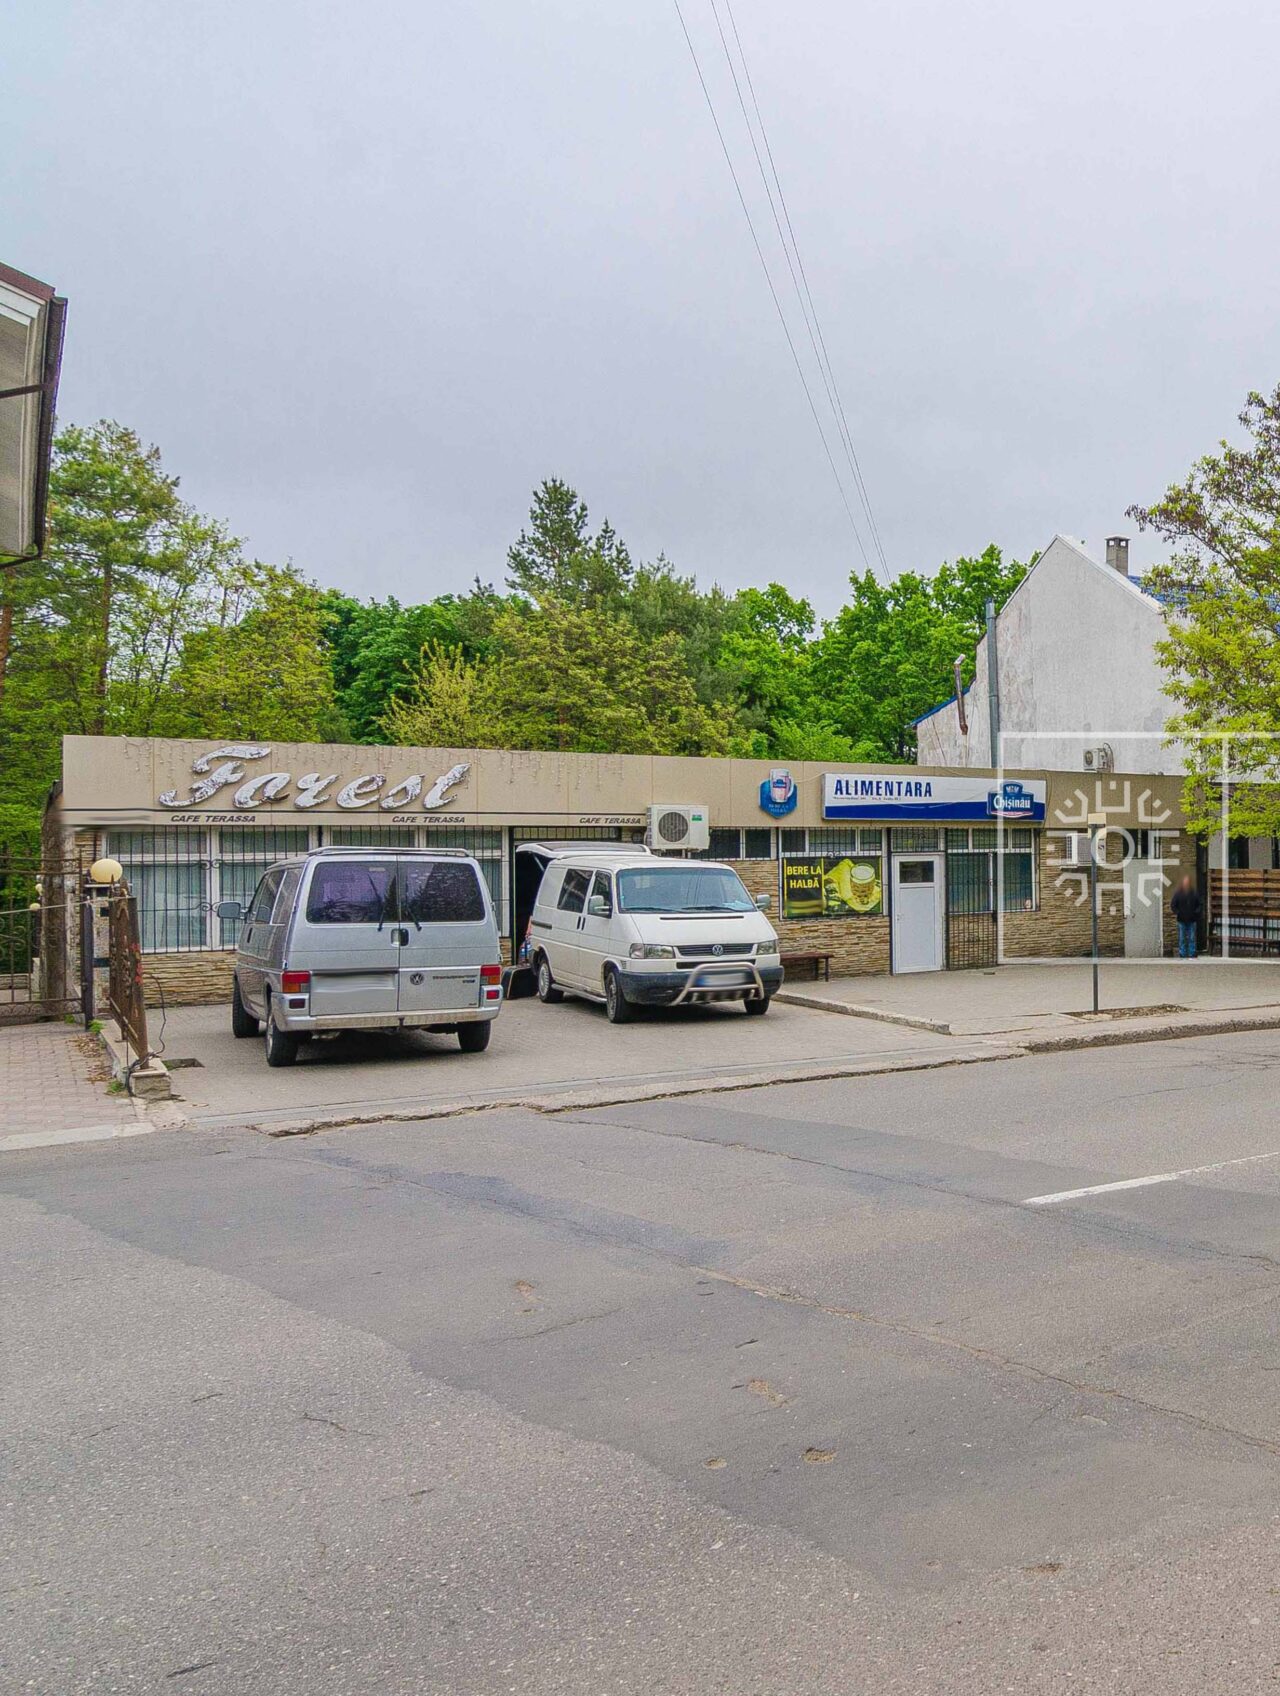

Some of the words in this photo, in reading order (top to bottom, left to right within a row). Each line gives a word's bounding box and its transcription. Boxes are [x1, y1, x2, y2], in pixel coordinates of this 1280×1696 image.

[834, 779, 932, 798] ALIMENTARA
[171, 815, 200, 823] CAFE
[205, 815, 256, 823] TERASSA
[604, 817, 641, 825] TERASSA
[787, 865, 808, 875] BERE
[811, 866, 822, 875] LA
[790, 877, 819, 888] HALBĂ
